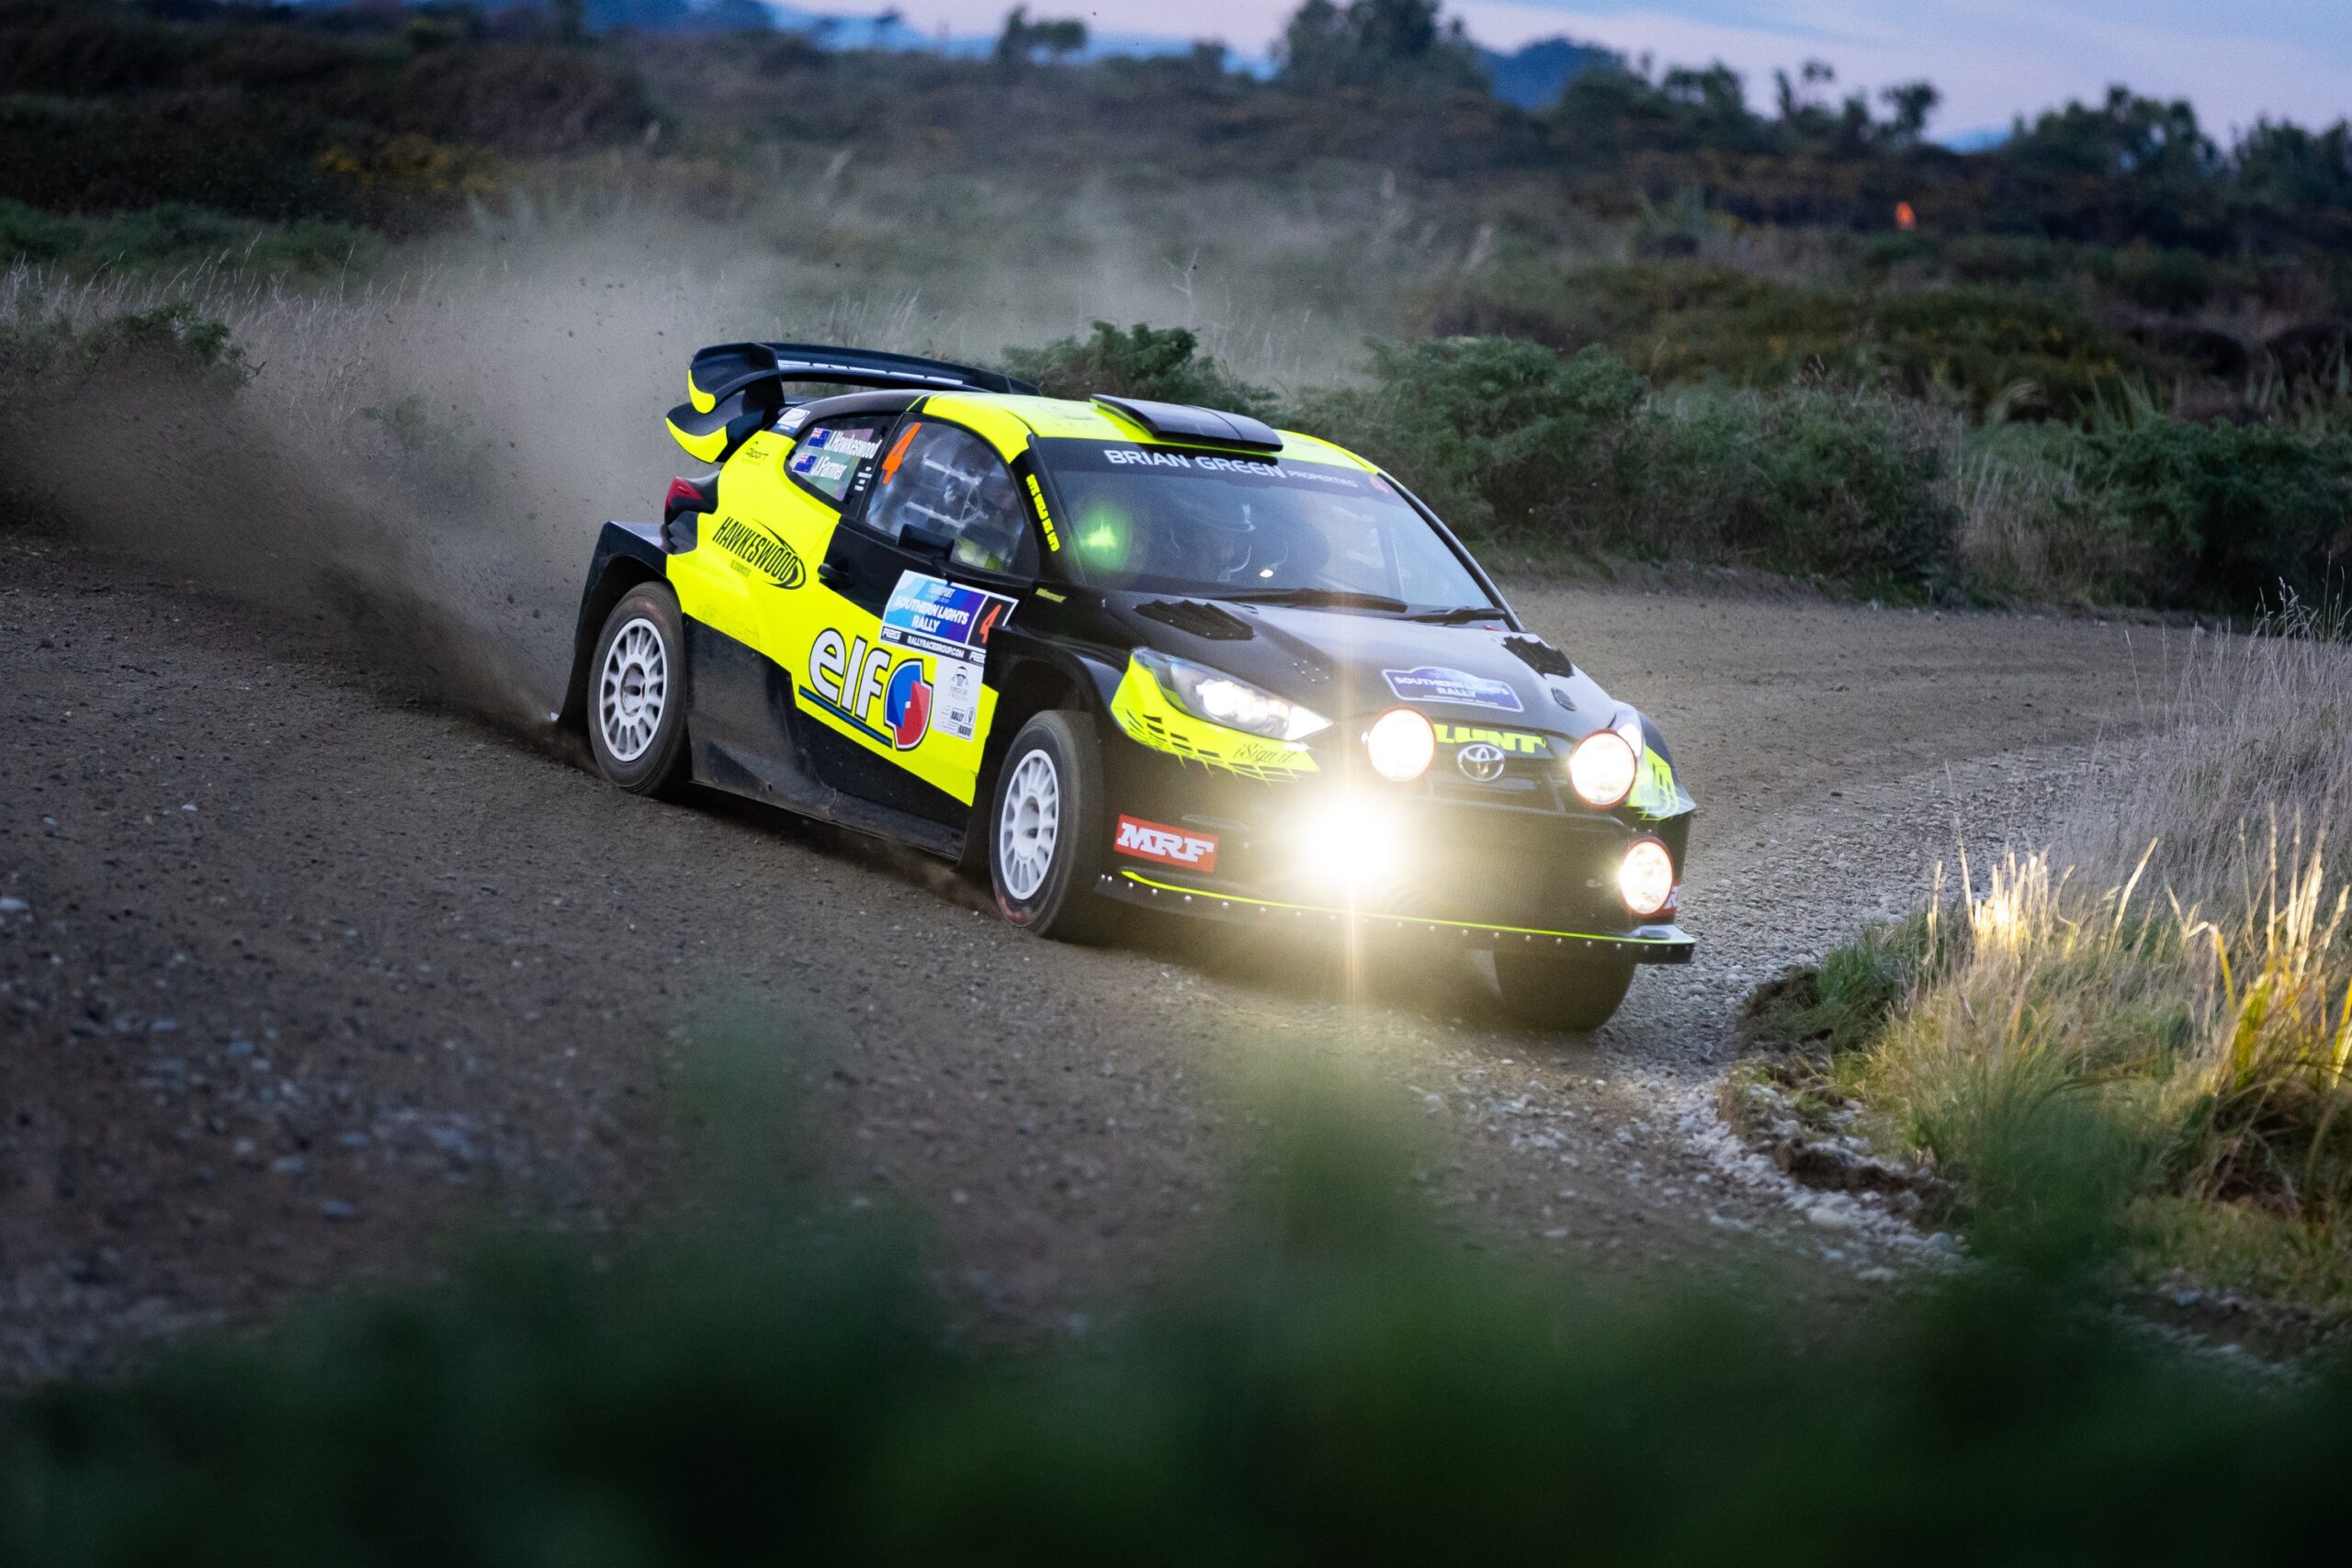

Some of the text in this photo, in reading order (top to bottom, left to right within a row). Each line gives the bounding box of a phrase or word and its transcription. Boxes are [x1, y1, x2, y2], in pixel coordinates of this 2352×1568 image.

[881, 422, 922, 485] 4
[1103, 449, 1191, 468] BRIAN
[1195, 456, 1286, 479] GREEN
[712, 516, 798, 581] HAWKESWOOD
[893, 595, 938, 616] SOUTHERN
[937, 604, 969, 625] LIGHTS
[911, 615, 940, 633] RALLY
[808, 626, 892, 722] elf
[1117, 822, 1215, 863] MRF
